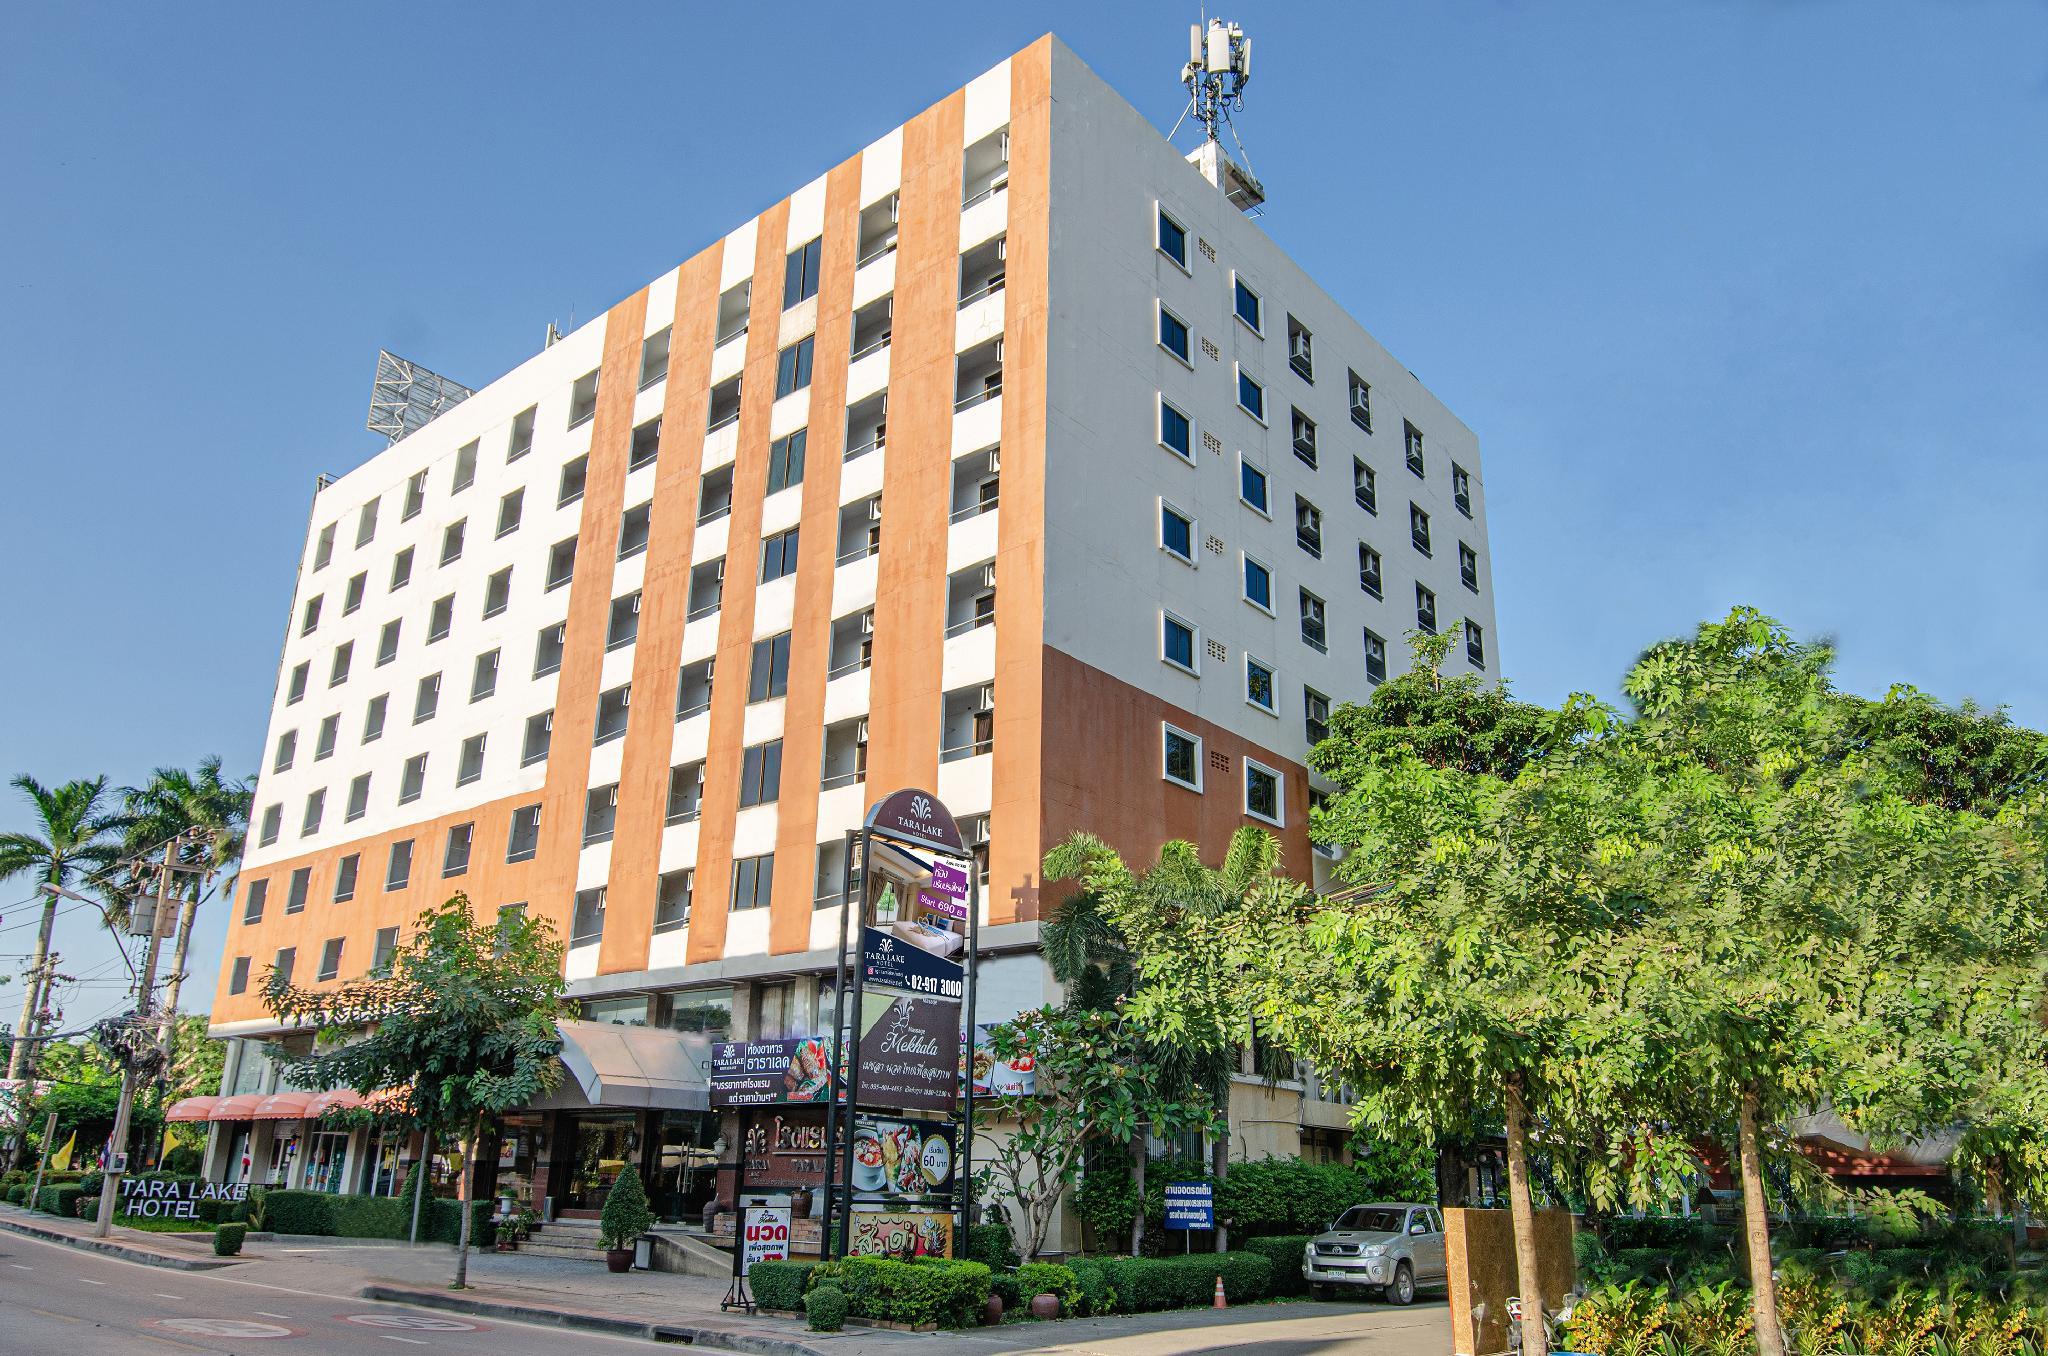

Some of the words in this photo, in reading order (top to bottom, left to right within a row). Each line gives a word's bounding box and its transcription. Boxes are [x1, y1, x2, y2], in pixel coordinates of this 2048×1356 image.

[898, 816, 920, 830] TARA
[922, 823, 943, 838] LAKE
[921, 894, 935, 907] Start
[938, 901, 955, 913] 690
[865, 951, 885, 960] TARA
[887, 953, 905, 963] LAKE
[911, 974, 938, 993] 02-917
[940, 978, 962, 997] 3000
[747, 1043, 783, 1055] ห้องอาหาร
[880, 1031, 939, 1056] Mekhala
[713, 1059, 729, 1067] TARA
[729, 1057, 745, 1066] LAKE
[923, 1155, 935, 1167] 60
[121, 1179, 181, 1199] TARA
[188, 1181, 249, 1200] LAKE
[126, 1198, 201, 1219] HOTEL
[746, 1224, 788, 1241] นวด
